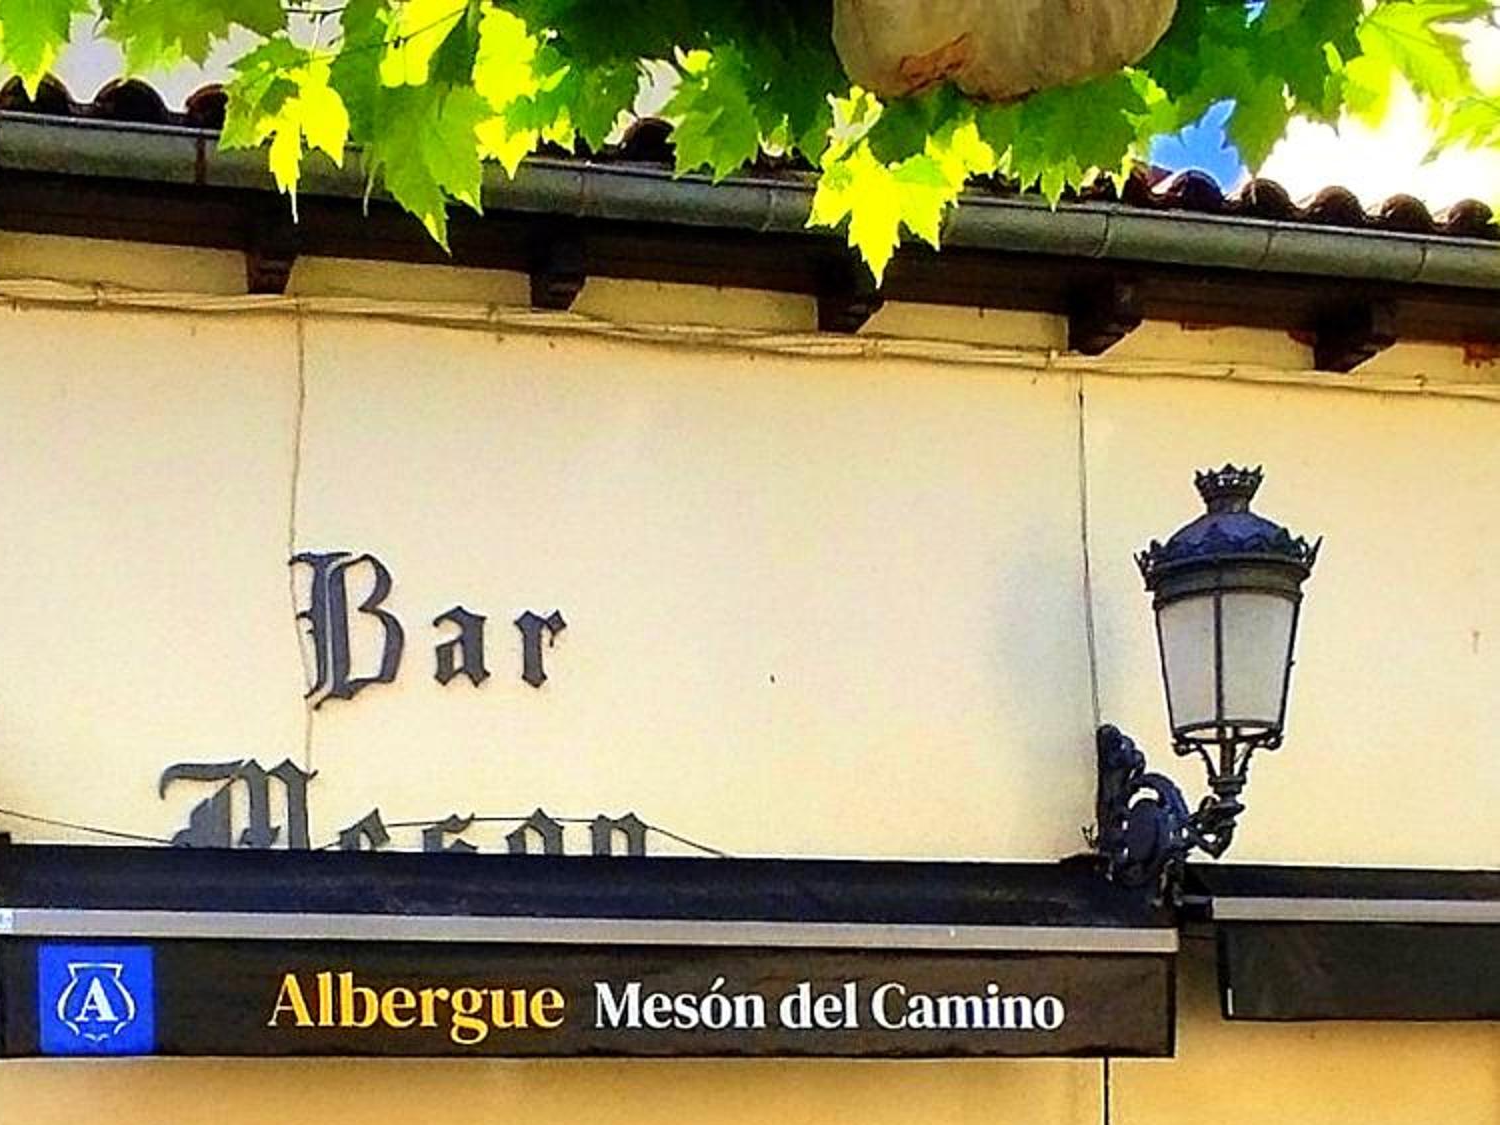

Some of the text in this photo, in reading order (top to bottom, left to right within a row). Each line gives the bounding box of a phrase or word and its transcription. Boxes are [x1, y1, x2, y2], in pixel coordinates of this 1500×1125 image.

[288, 551, 567, 710] Bar
[74, 976, 120, 1022] A
[268, 972, 1066, 1044] Albergue Mesón del Camino
